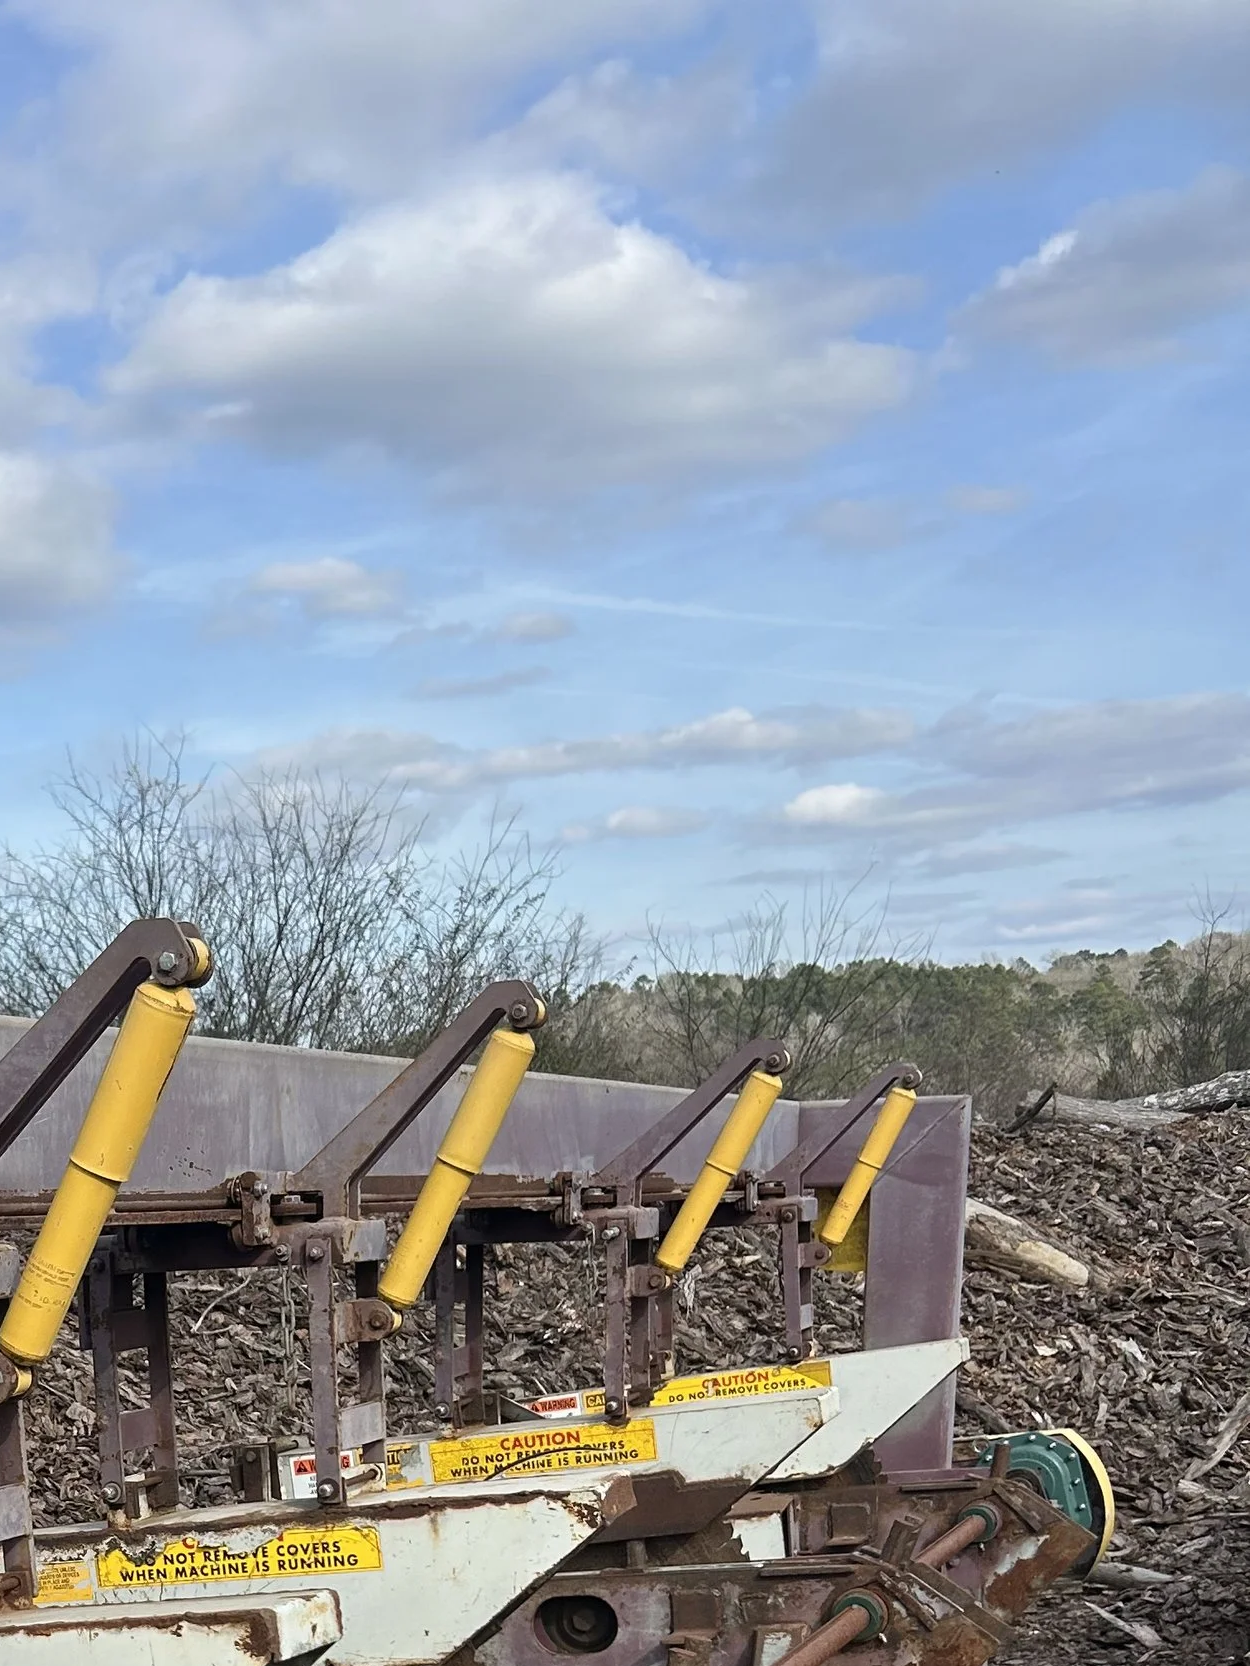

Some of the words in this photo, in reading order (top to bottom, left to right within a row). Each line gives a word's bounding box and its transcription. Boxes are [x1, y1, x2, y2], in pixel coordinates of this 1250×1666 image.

[669, 1395, 683, 1403] DO
[715, 1385, 758, 1396] REMOVE
[764, 1378, 806, 1390] COVERS
[702, 1371, 769, 1389] CAUTION
[541, 1398, 576, 1412] WARNING
[500, 1431, 580, 1451] CAUTION
[450, 1466, 489, 1478] WHEN
[558, 1457, 569, 1466] IS
[575, 1449, 638, 1464] RUNNING
[462, 1456, 479, 1466] DO
[485, 1453, 510, 1463] NOT
[163, 1551, 196, 1565] NOT
[276, 1541, 341, 1557] COVERS
[120, 1568, 167, 1582] WHEN
[175, 1562, 248, 1578] MACHINE
[256, 1560, 270, 1572] IS
[278, 1554, 358, 1571] RUNNING
